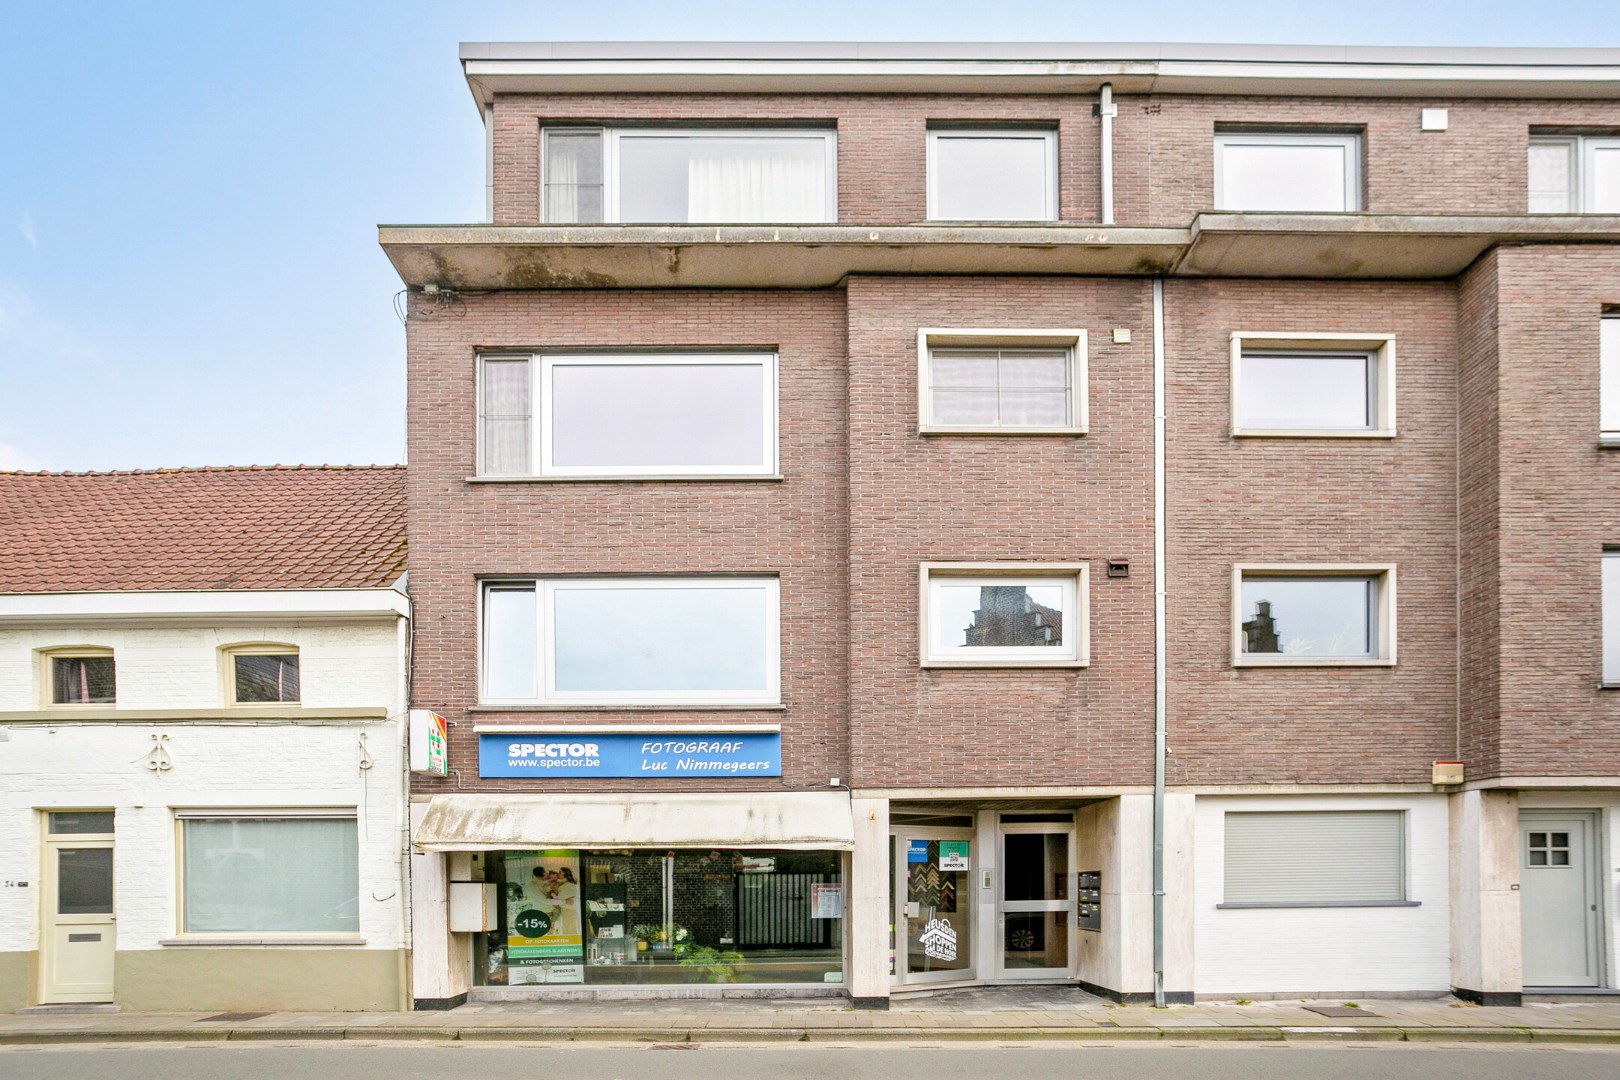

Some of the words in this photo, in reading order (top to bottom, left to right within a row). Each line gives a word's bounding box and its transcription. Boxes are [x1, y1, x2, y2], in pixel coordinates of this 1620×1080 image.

[508, 743, 600, 757] SPECTOR
[641, 741, 743, 754] FOTOGRAAF
[508, 757, 600, 768] www.spector.be
[641, 759, 668, 771] Luc
[676, 758, 770, 773] Nimmegeers
[517, 918, 548, 929] -15%
[925, 918, 957, 939] HEUSDEN
[925, 934, 957, 952] SHOPPEN
[925, 944, 936, 955] OM
[936, 944, 944, 953] DE
